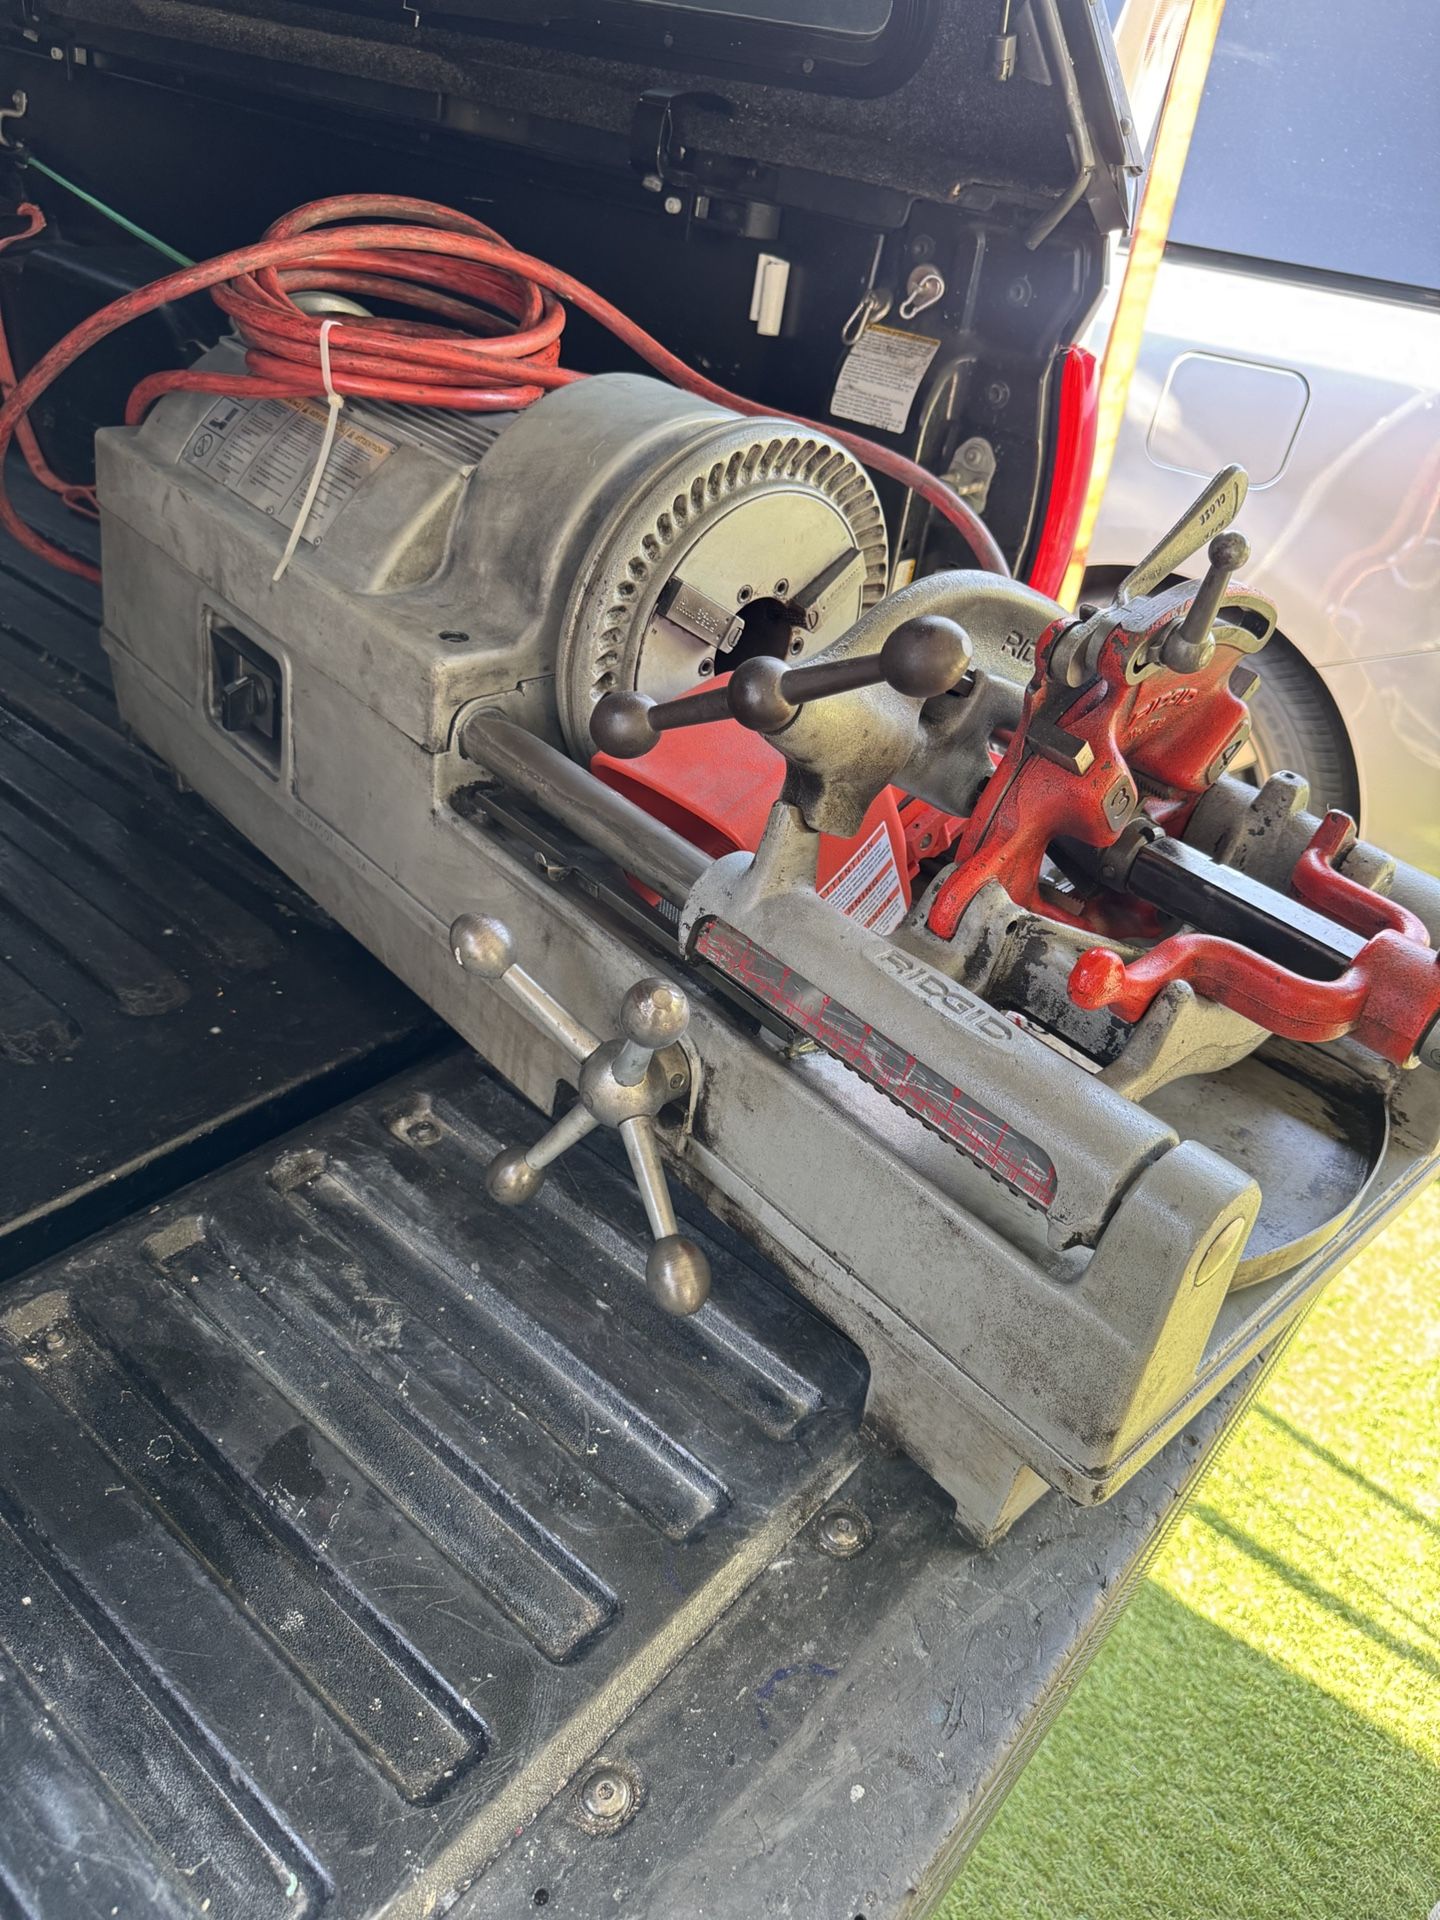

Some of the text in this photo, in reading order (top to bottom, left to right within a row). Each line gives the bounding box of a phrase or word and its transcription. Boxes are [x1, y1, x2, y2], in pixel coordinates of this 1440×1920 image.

[1199, 493, 1226, 526] CLOSE
[1111, 788, 1130, 819] 3
[819, 842, 873, 900] TTENTION
[877, 950, 1013, 1041] RIDGID
